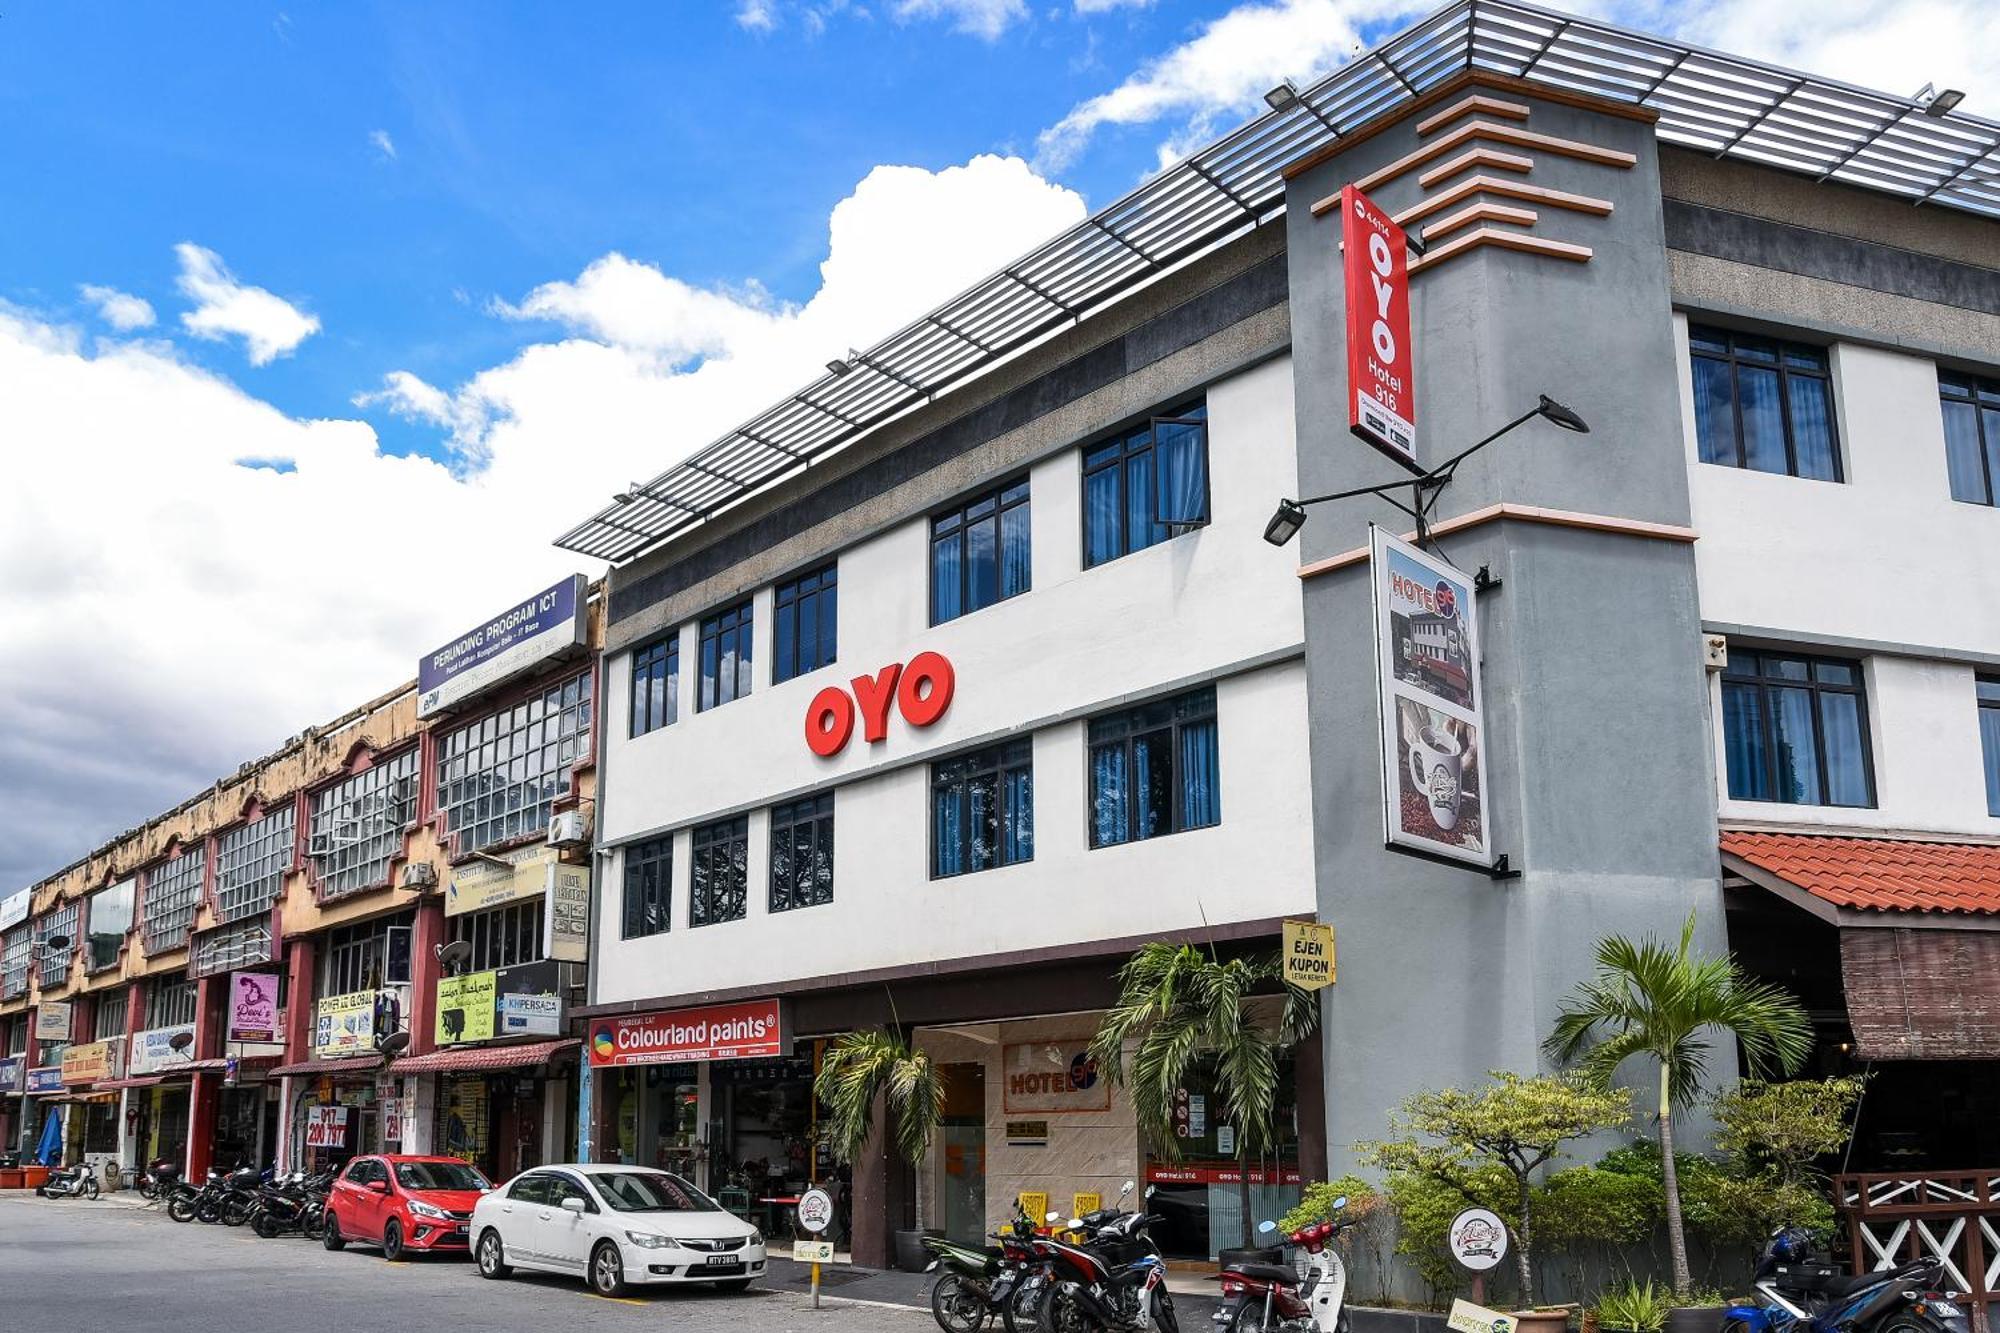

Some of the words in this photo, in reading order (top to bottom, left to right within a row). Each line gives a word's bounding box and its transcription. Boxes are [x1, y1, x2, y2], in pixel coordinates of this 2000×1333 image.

[1369, 232, 1396, 365] OYO
[1368, 356, 1402, 394] Hotel
[1375, 383, 1397, 412] 916
[433, 631, 484, 670] PERUNDING
[486, 602, 536, 641] PROGRAM
[539, 591, 557, 613] ICT
[805, 651, 955, 757] OYO
[1294, 940, 1323, 956] EJEN
[1289, 957, 1329, 973] KUPON
[618, 1020, 706, 1049] Colourland
[1010, 1072, 1078, 1095] HOTEL
[320, 1108, 337, 1123] 017
[308, 1122, 325, 1144] 200
